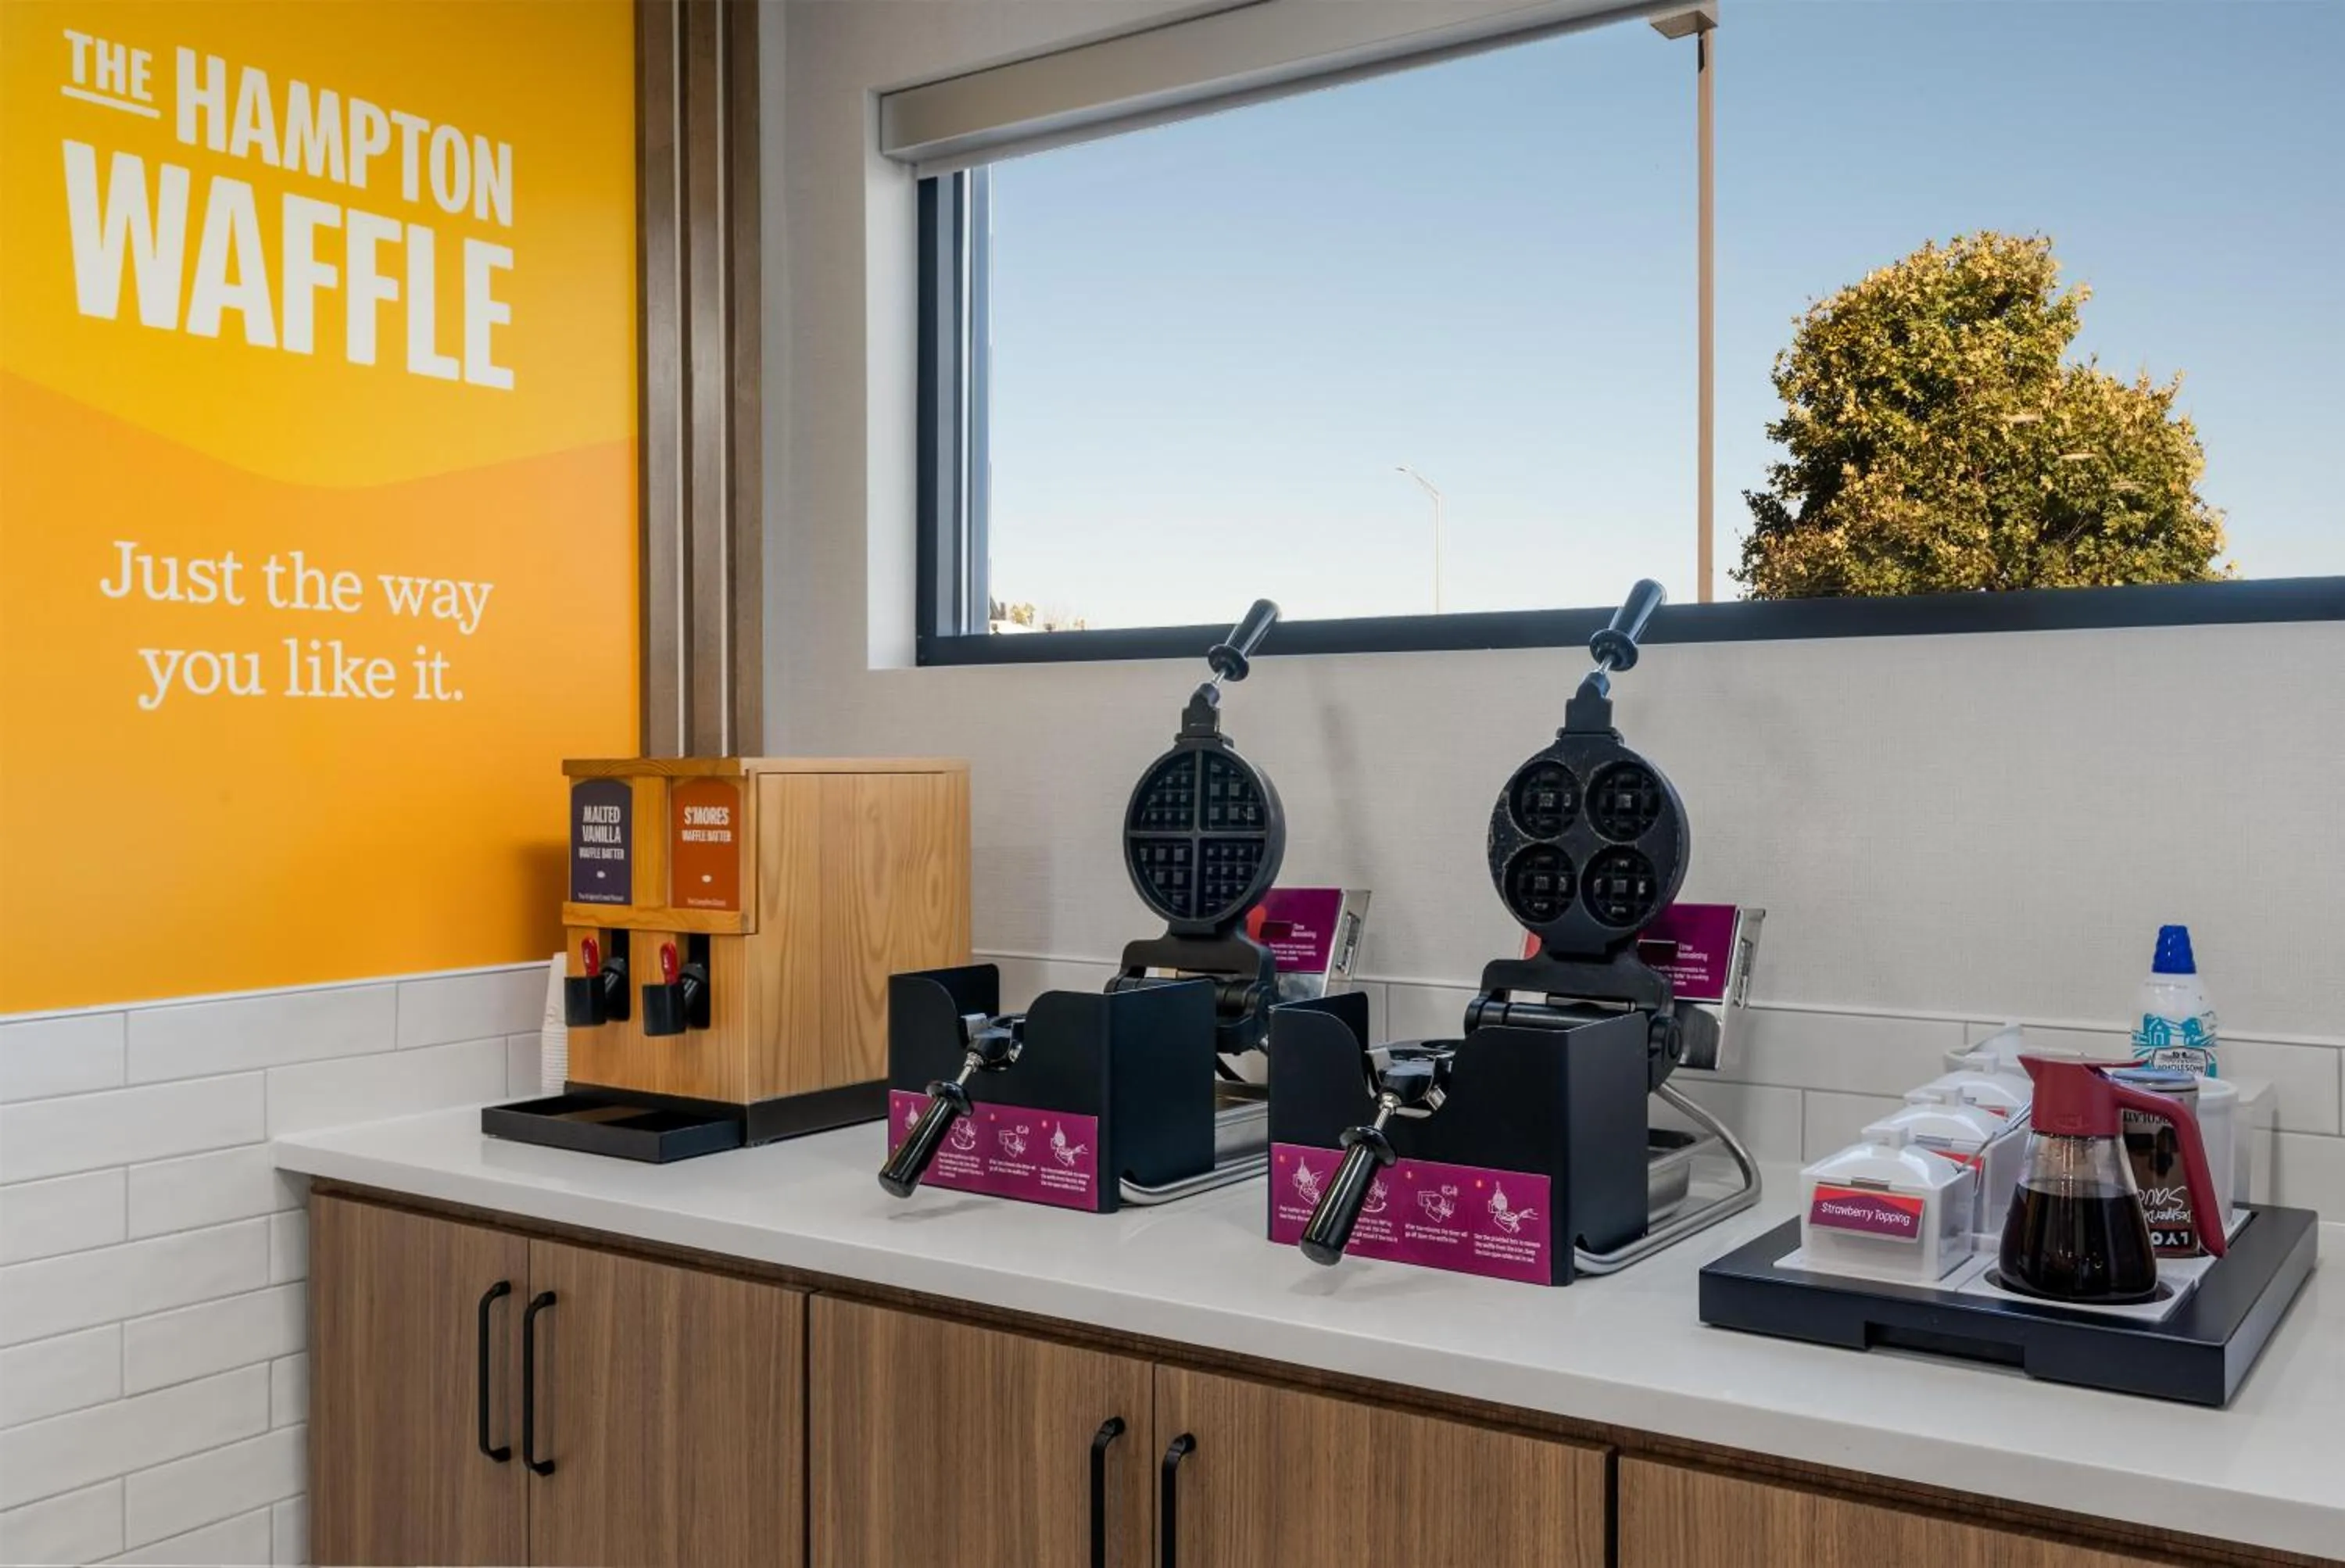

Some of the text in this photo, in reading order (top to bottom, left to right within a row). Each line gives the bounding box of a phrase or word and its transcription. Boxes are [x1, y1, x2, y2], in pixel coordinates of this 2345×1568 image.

[63, 29, 514, 227] THE HAMPTON
[62, 139, 514, 391] WAFFLE
[99, 540, 494, 635] Just the way
[138, 638, 464, 711] you like it.
[583, 805, 621, 823] MALTED
[684, 806, 729, 825] S'MORES
[582, 825, 621, 843] VANILLA
[1821, 1202, 1911, 1226] Strawberry Topping
[2150, 1231, 2189, 1246] LYO
